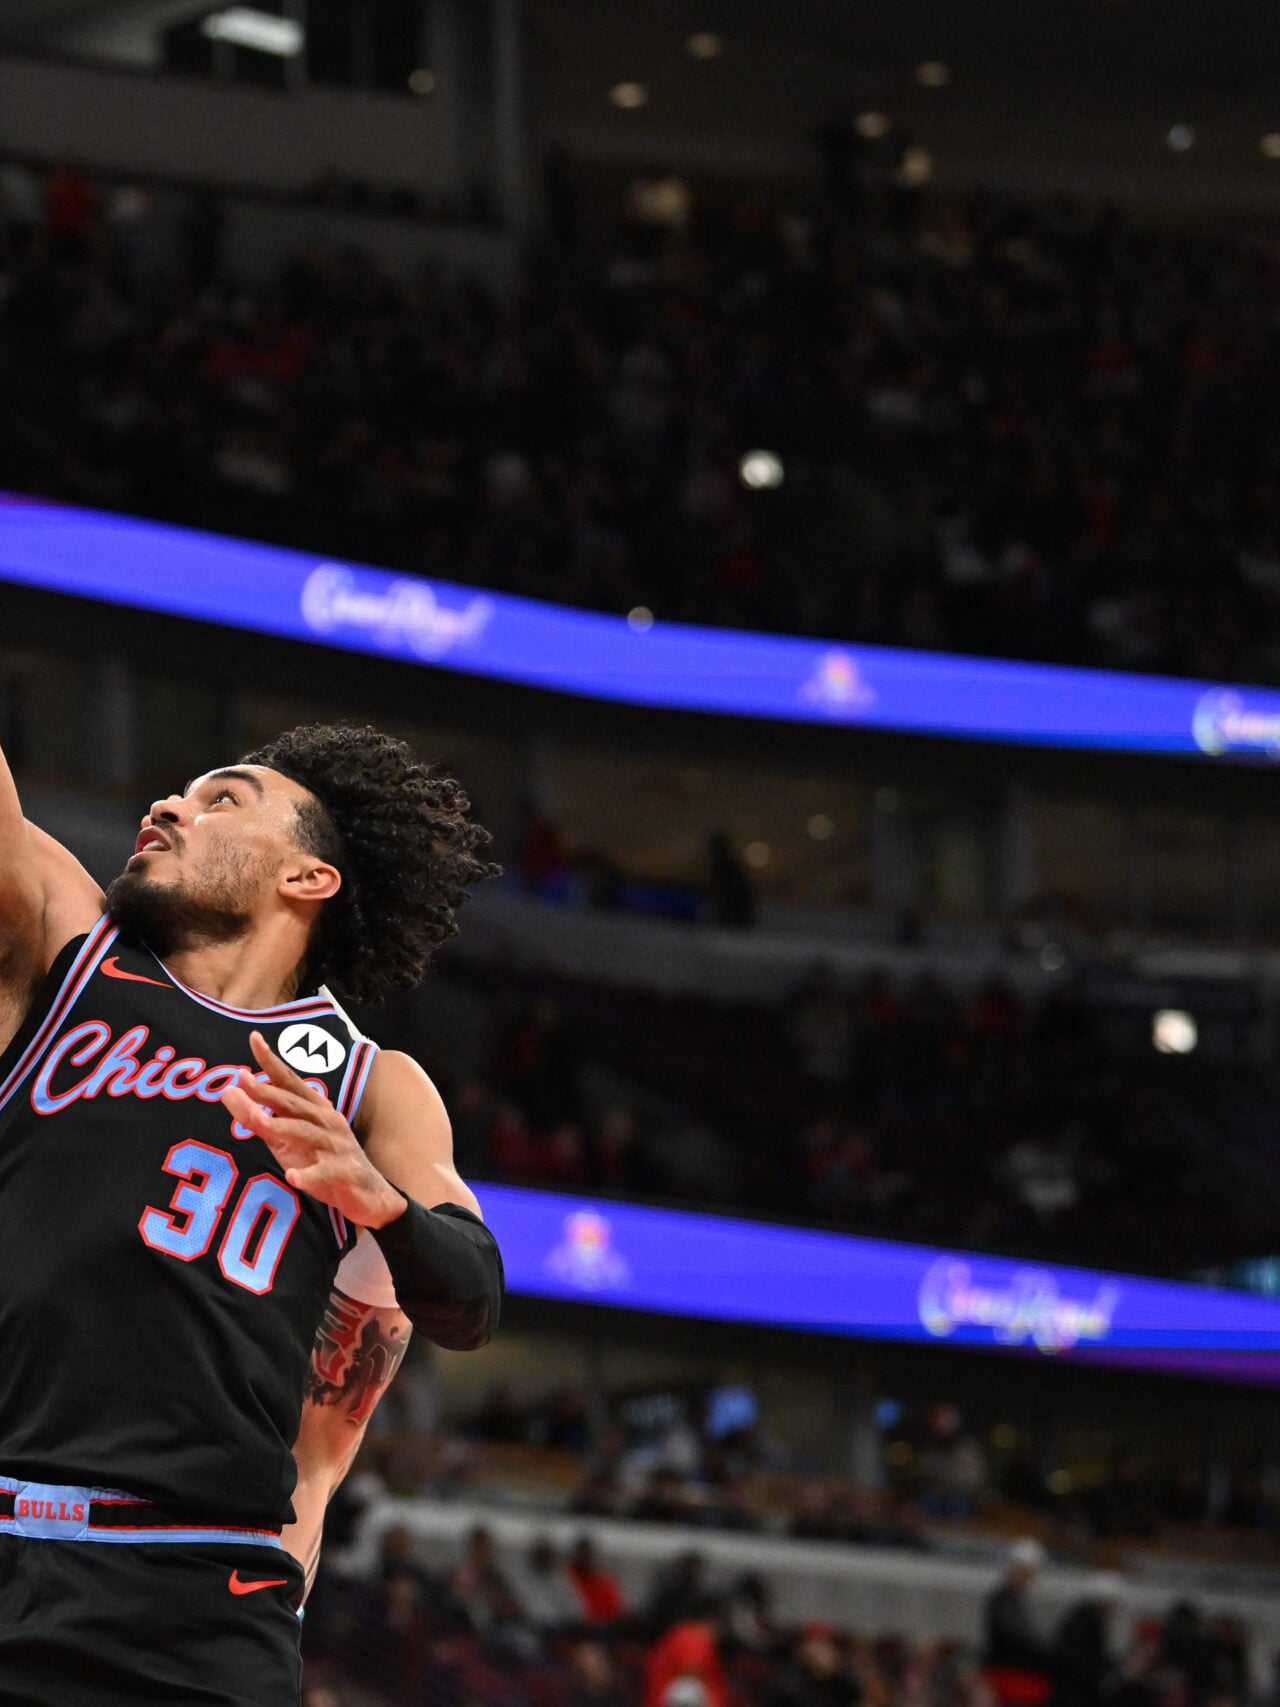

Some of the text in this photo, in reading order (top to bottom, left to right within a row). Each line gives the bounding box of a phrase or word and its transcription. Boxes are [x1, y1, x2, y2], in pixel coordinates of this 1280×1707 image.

[31, 1020, 329, 1139] Chica
[137, 1138, 301, 1295] 30
[18, 1500, 84, 1521] BULLS
